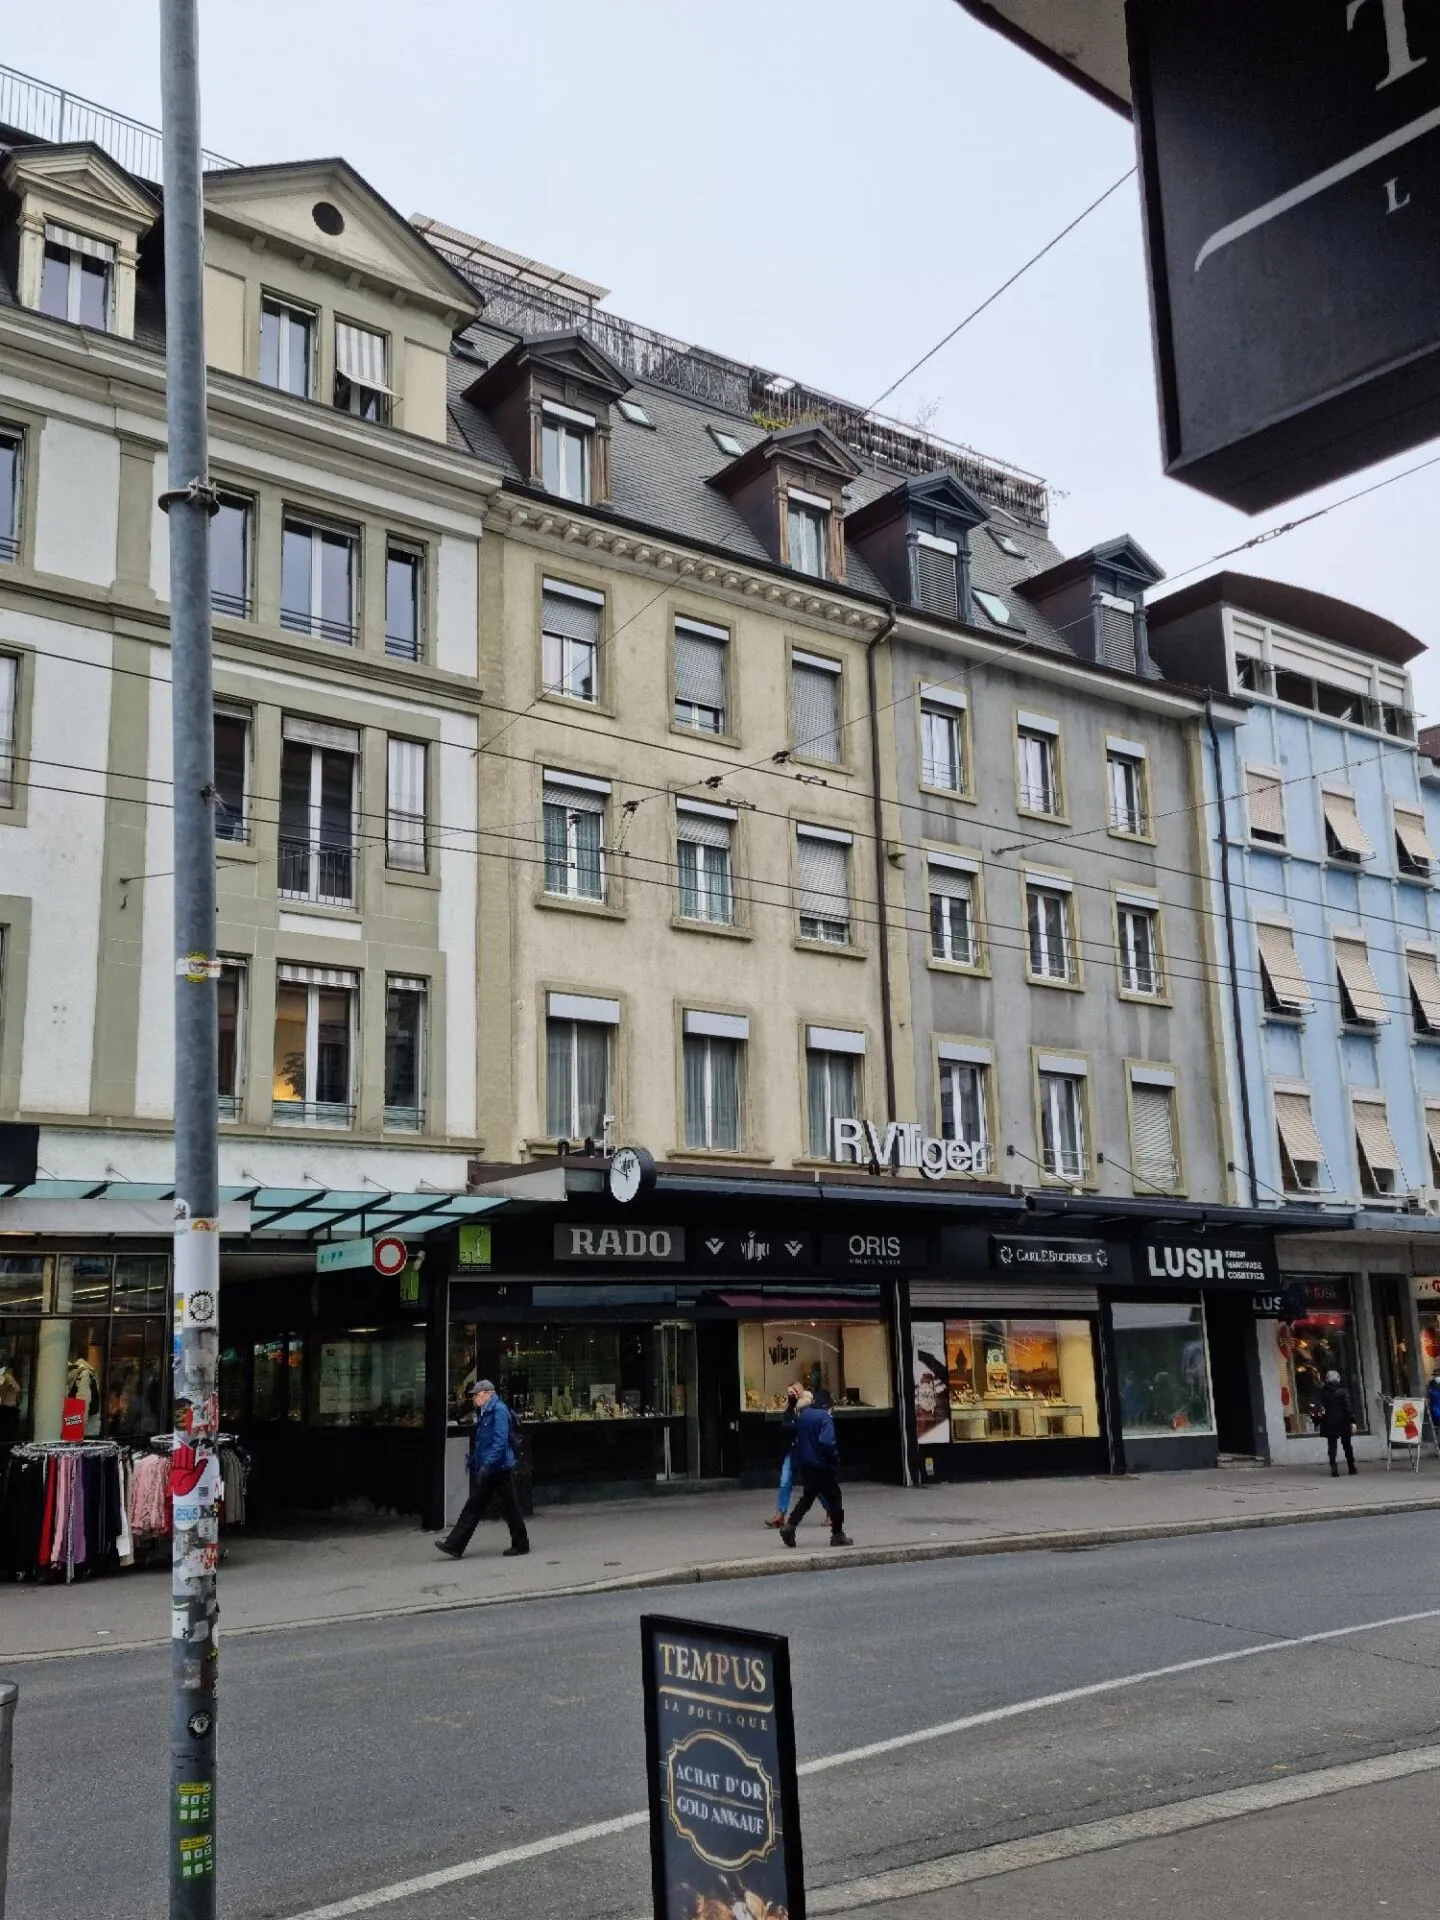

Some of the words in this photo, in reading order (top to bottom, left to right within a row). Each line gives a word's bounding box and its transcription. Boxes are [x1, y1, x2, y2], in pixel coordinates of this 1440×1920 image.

[1384, 177, 1411, 215] L
[569, 1228, 672, 1257] RADO
[849, 1235, 900, 1257] ORIS
[1148, 1246, 1224, 1279] LUSH
[1227, 1271, 1265, 1280] COSMETICS
[1252, 1296, 1284, 1311] LUS
[658, 1642, 767, 1693] TEMPUS
[664, 1699, 680, 1713] LA
[687, 1704, 769, 1731] BOUTIQUE
[676, 1763, 720, 1790] ACHAT
[725, 1776, 764, 1800] D'OR
[676, 1796, 708, 1820] GOLD
[711, 1807, 765, 1836] ANKAUF
